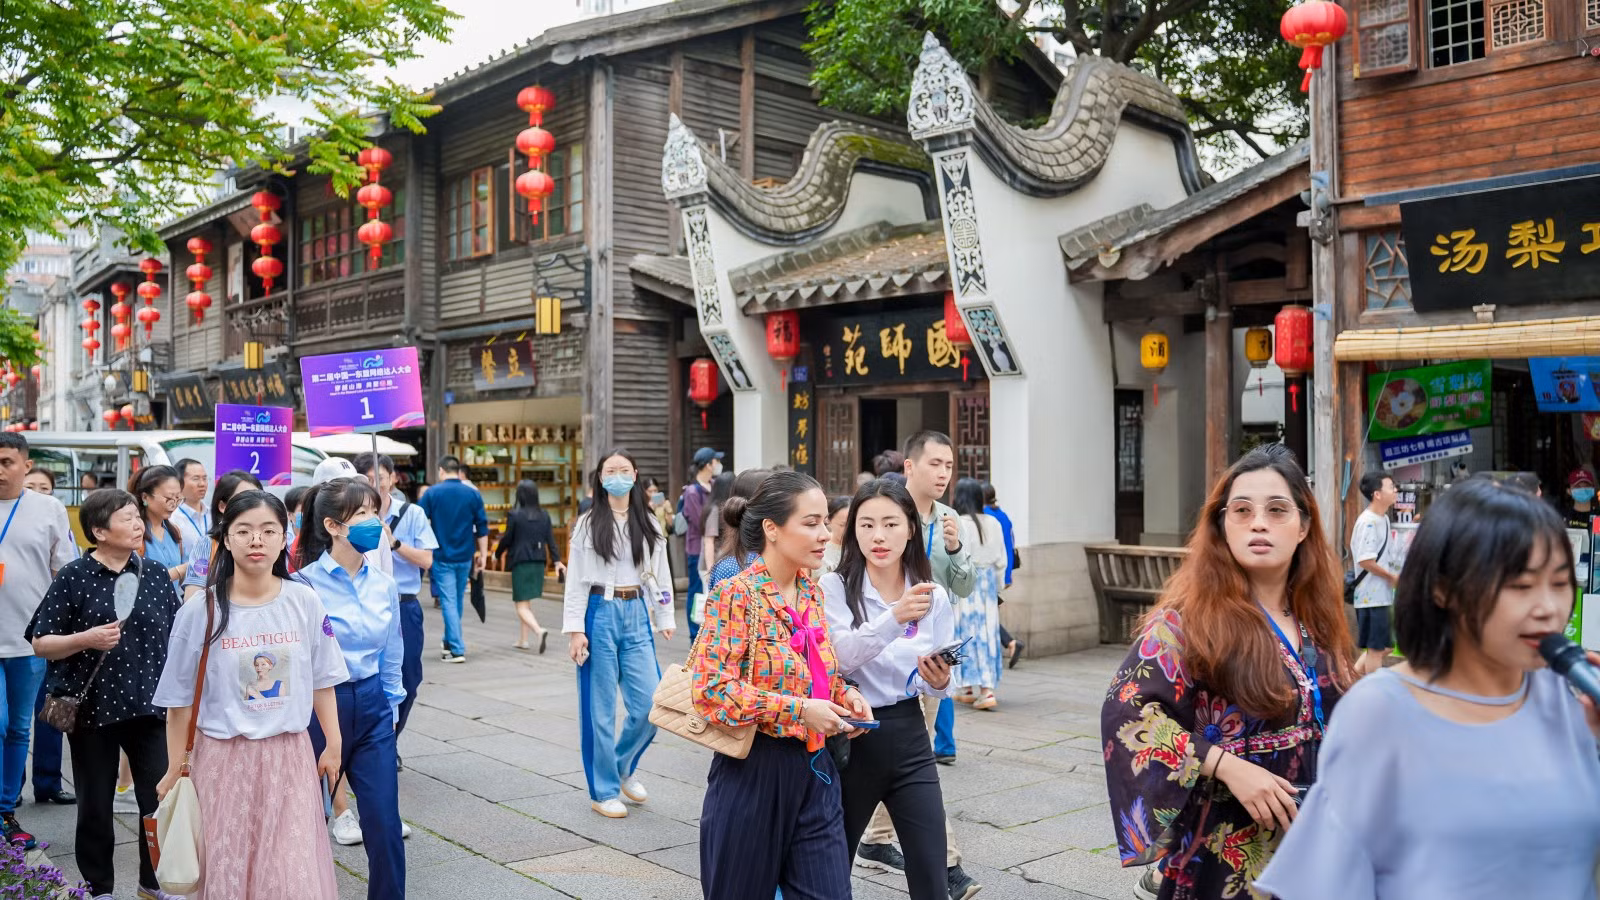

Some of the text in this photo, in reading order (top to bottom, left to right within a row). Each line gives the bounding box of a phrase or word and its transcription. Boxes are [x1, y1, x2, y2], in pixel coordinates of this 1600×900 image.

[774, 320, 793, 343] 福
[360, 396, 374, 420] 1
[249, 451, 260, 474] 2
[1397, 511, 1413, 523] 10
[221, 630, 301, 650] BEAUTIGUL
